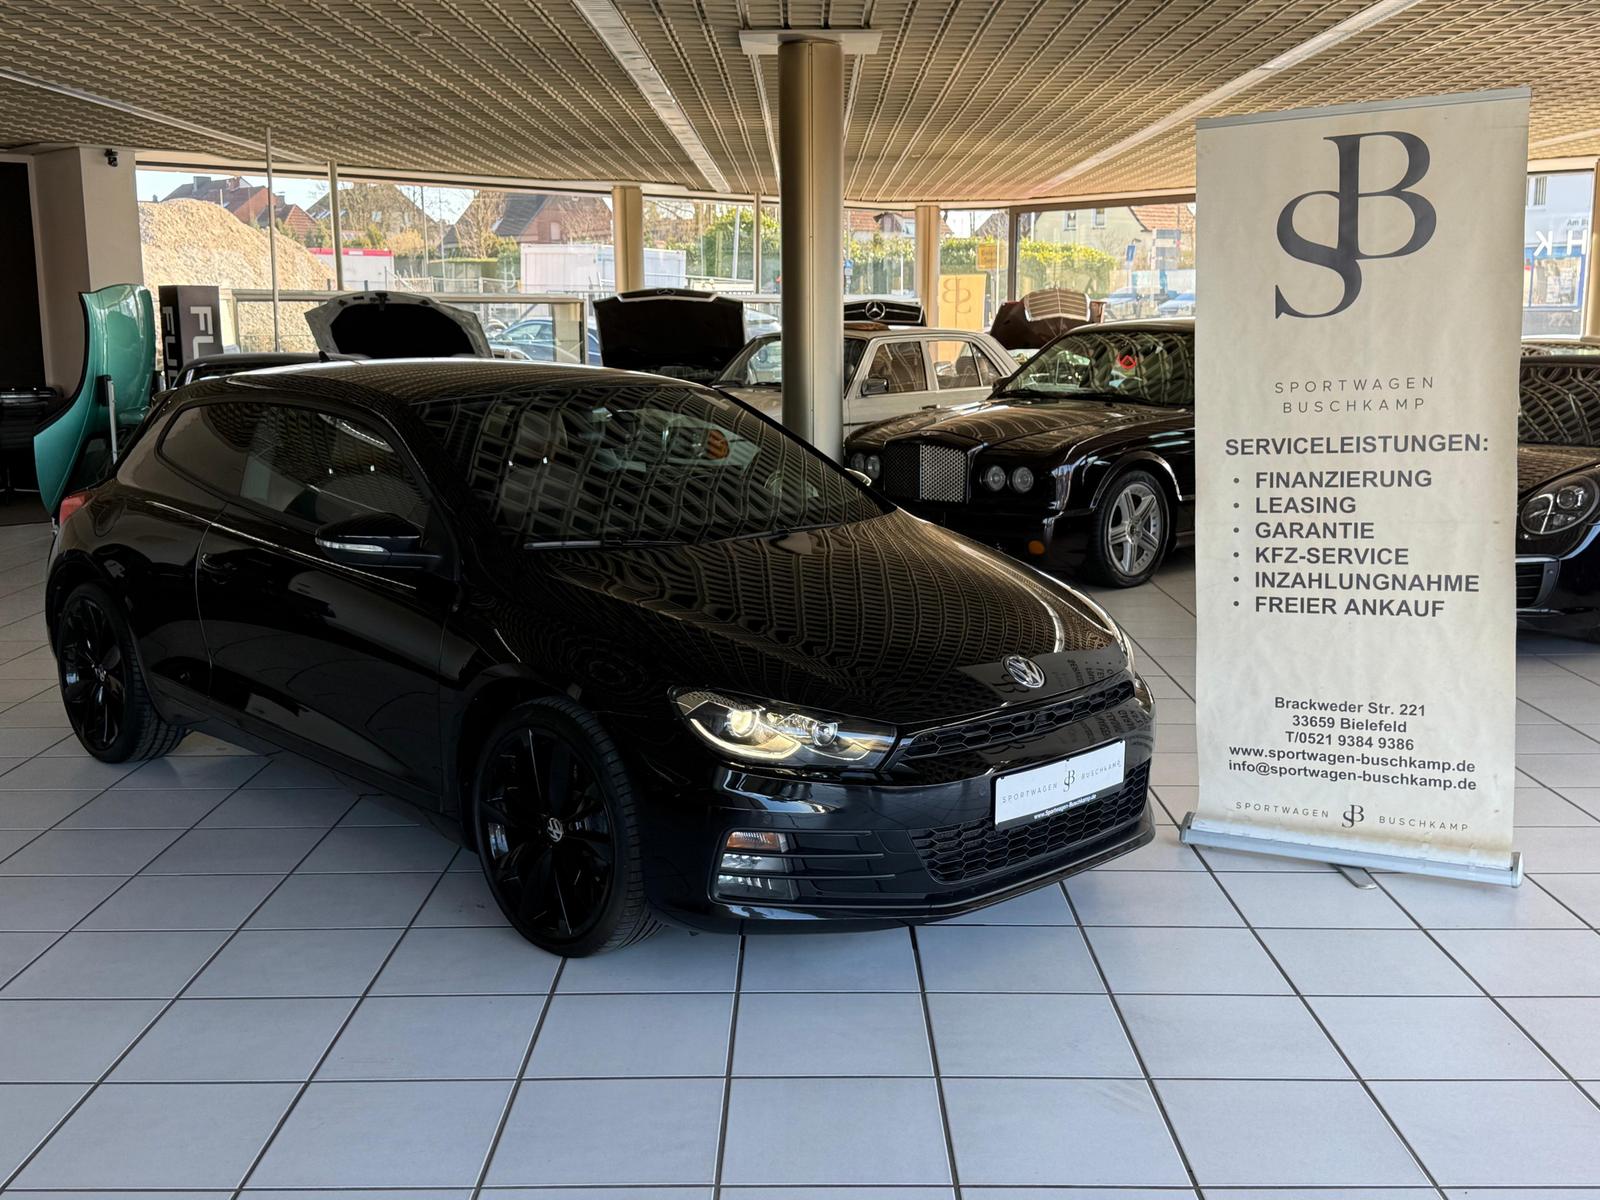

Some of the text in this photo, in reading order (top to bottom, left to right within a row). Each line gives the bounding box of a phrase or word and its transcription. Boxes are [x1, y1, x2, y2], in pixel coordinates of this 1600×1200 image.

[1275, 376, 1434, 394] SPORTWAGEN
[1283, 398, 1424, 414] BUSCHKAMP
[1225, 434, 1489, 456] SERVICELEISTUNGEN:
[1255, 470, 1432, 489] FINANZIERUNG
[1255, 496, 1357, 514] LEASING
[1255, 522, 1375, 539] GARANTIE
[1255, 546, 1409, 565] KFZ-SERVICE
[1255, 571, 1480, 593] INZAHLUNGNAHME
[1255, 596, 1445, 617] FREIER ANKAUF
[1274, 696, 1426, 717] Brackweder Str. 221
[1292, 714, 1407, 733] 33659 Bielefeld
[1285, 730, 1415, 751] T/0521 9384 9386
[1229, 746, 1476, 773] www.sportwagen-buschkamp.de
[1229, 760, 1477, 791] info@sportwagen-buschkamp.de
[1002, 783, 1058, 804] SPORTWAGEN
[1236, 801, 1329, 818] SPORTWAGEN
[1379, 816, 1469, 831] BUSCHKAMP
